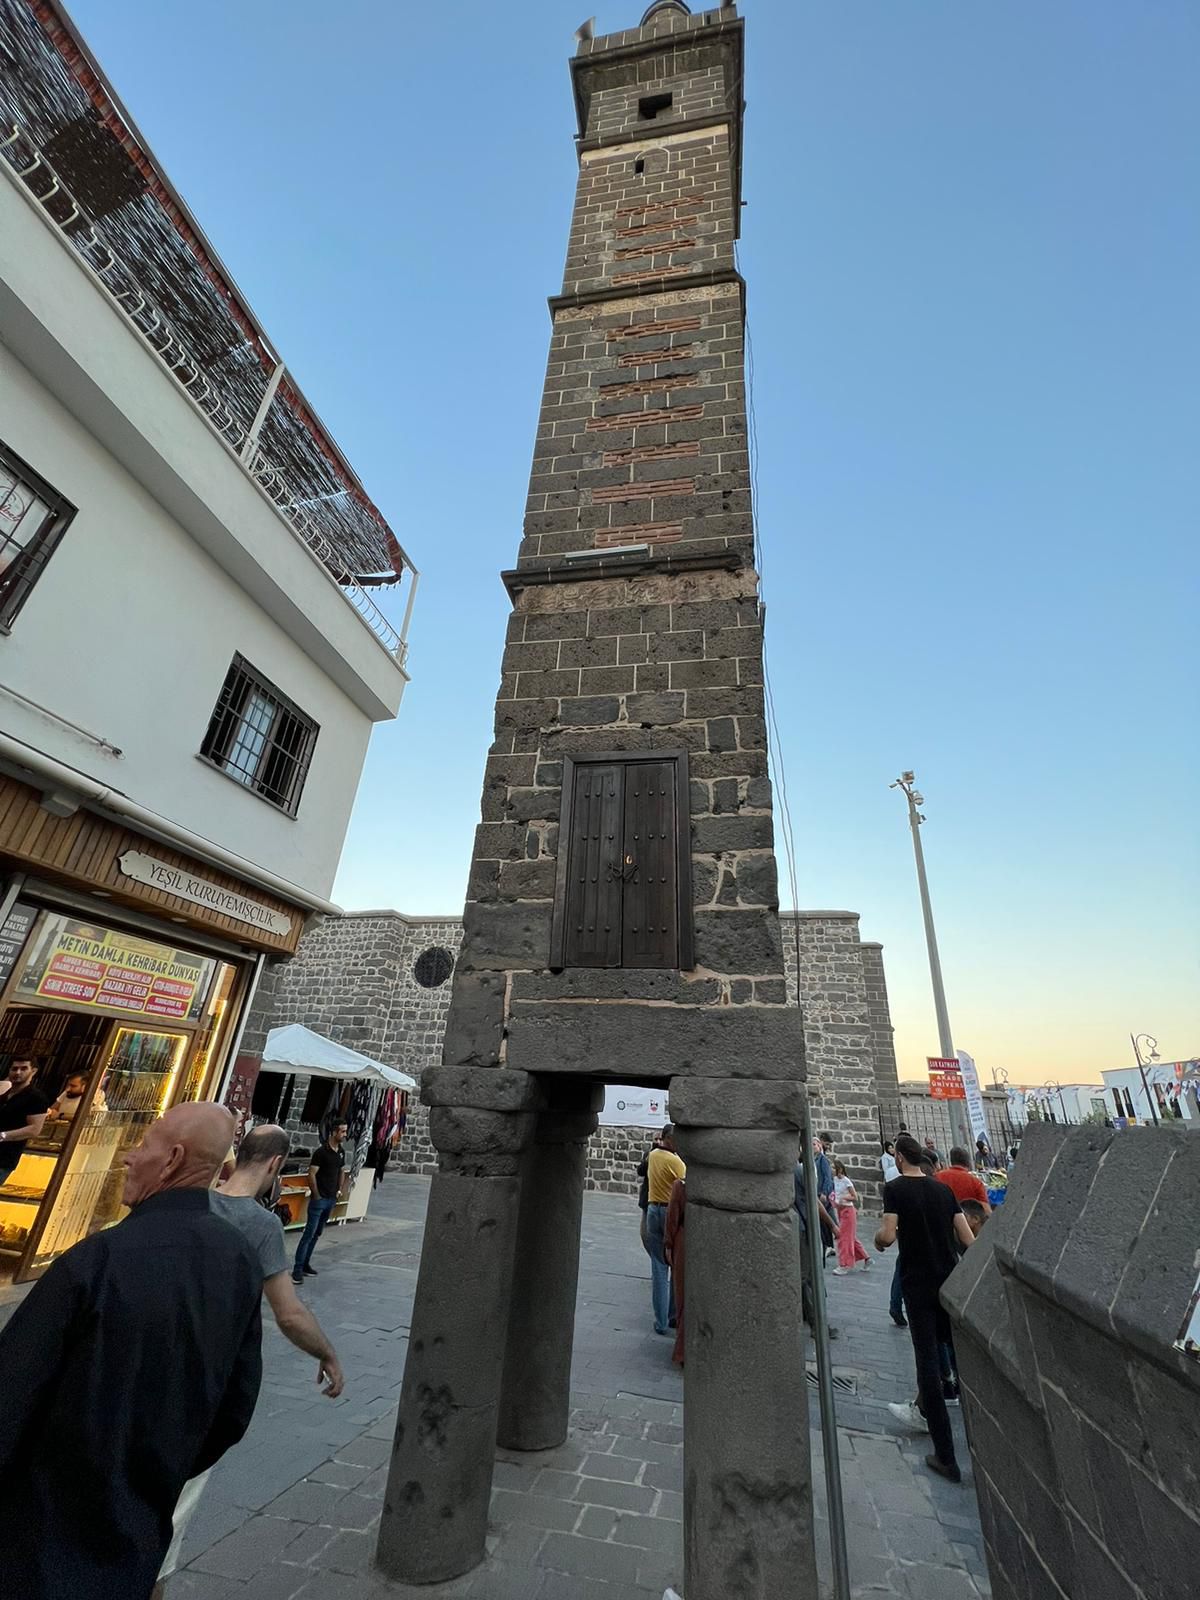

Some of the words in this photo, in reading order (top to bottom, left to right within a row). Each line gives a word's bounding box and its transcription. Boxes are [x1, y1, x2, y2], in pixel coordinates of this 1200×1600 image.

[150, 864, 183, 888] YEŞİL
[57, 935, 91, 955] METİN
[91, 944, 125, 964] DAMLA
[126, 953, 168, 974] KEHRİBAR
